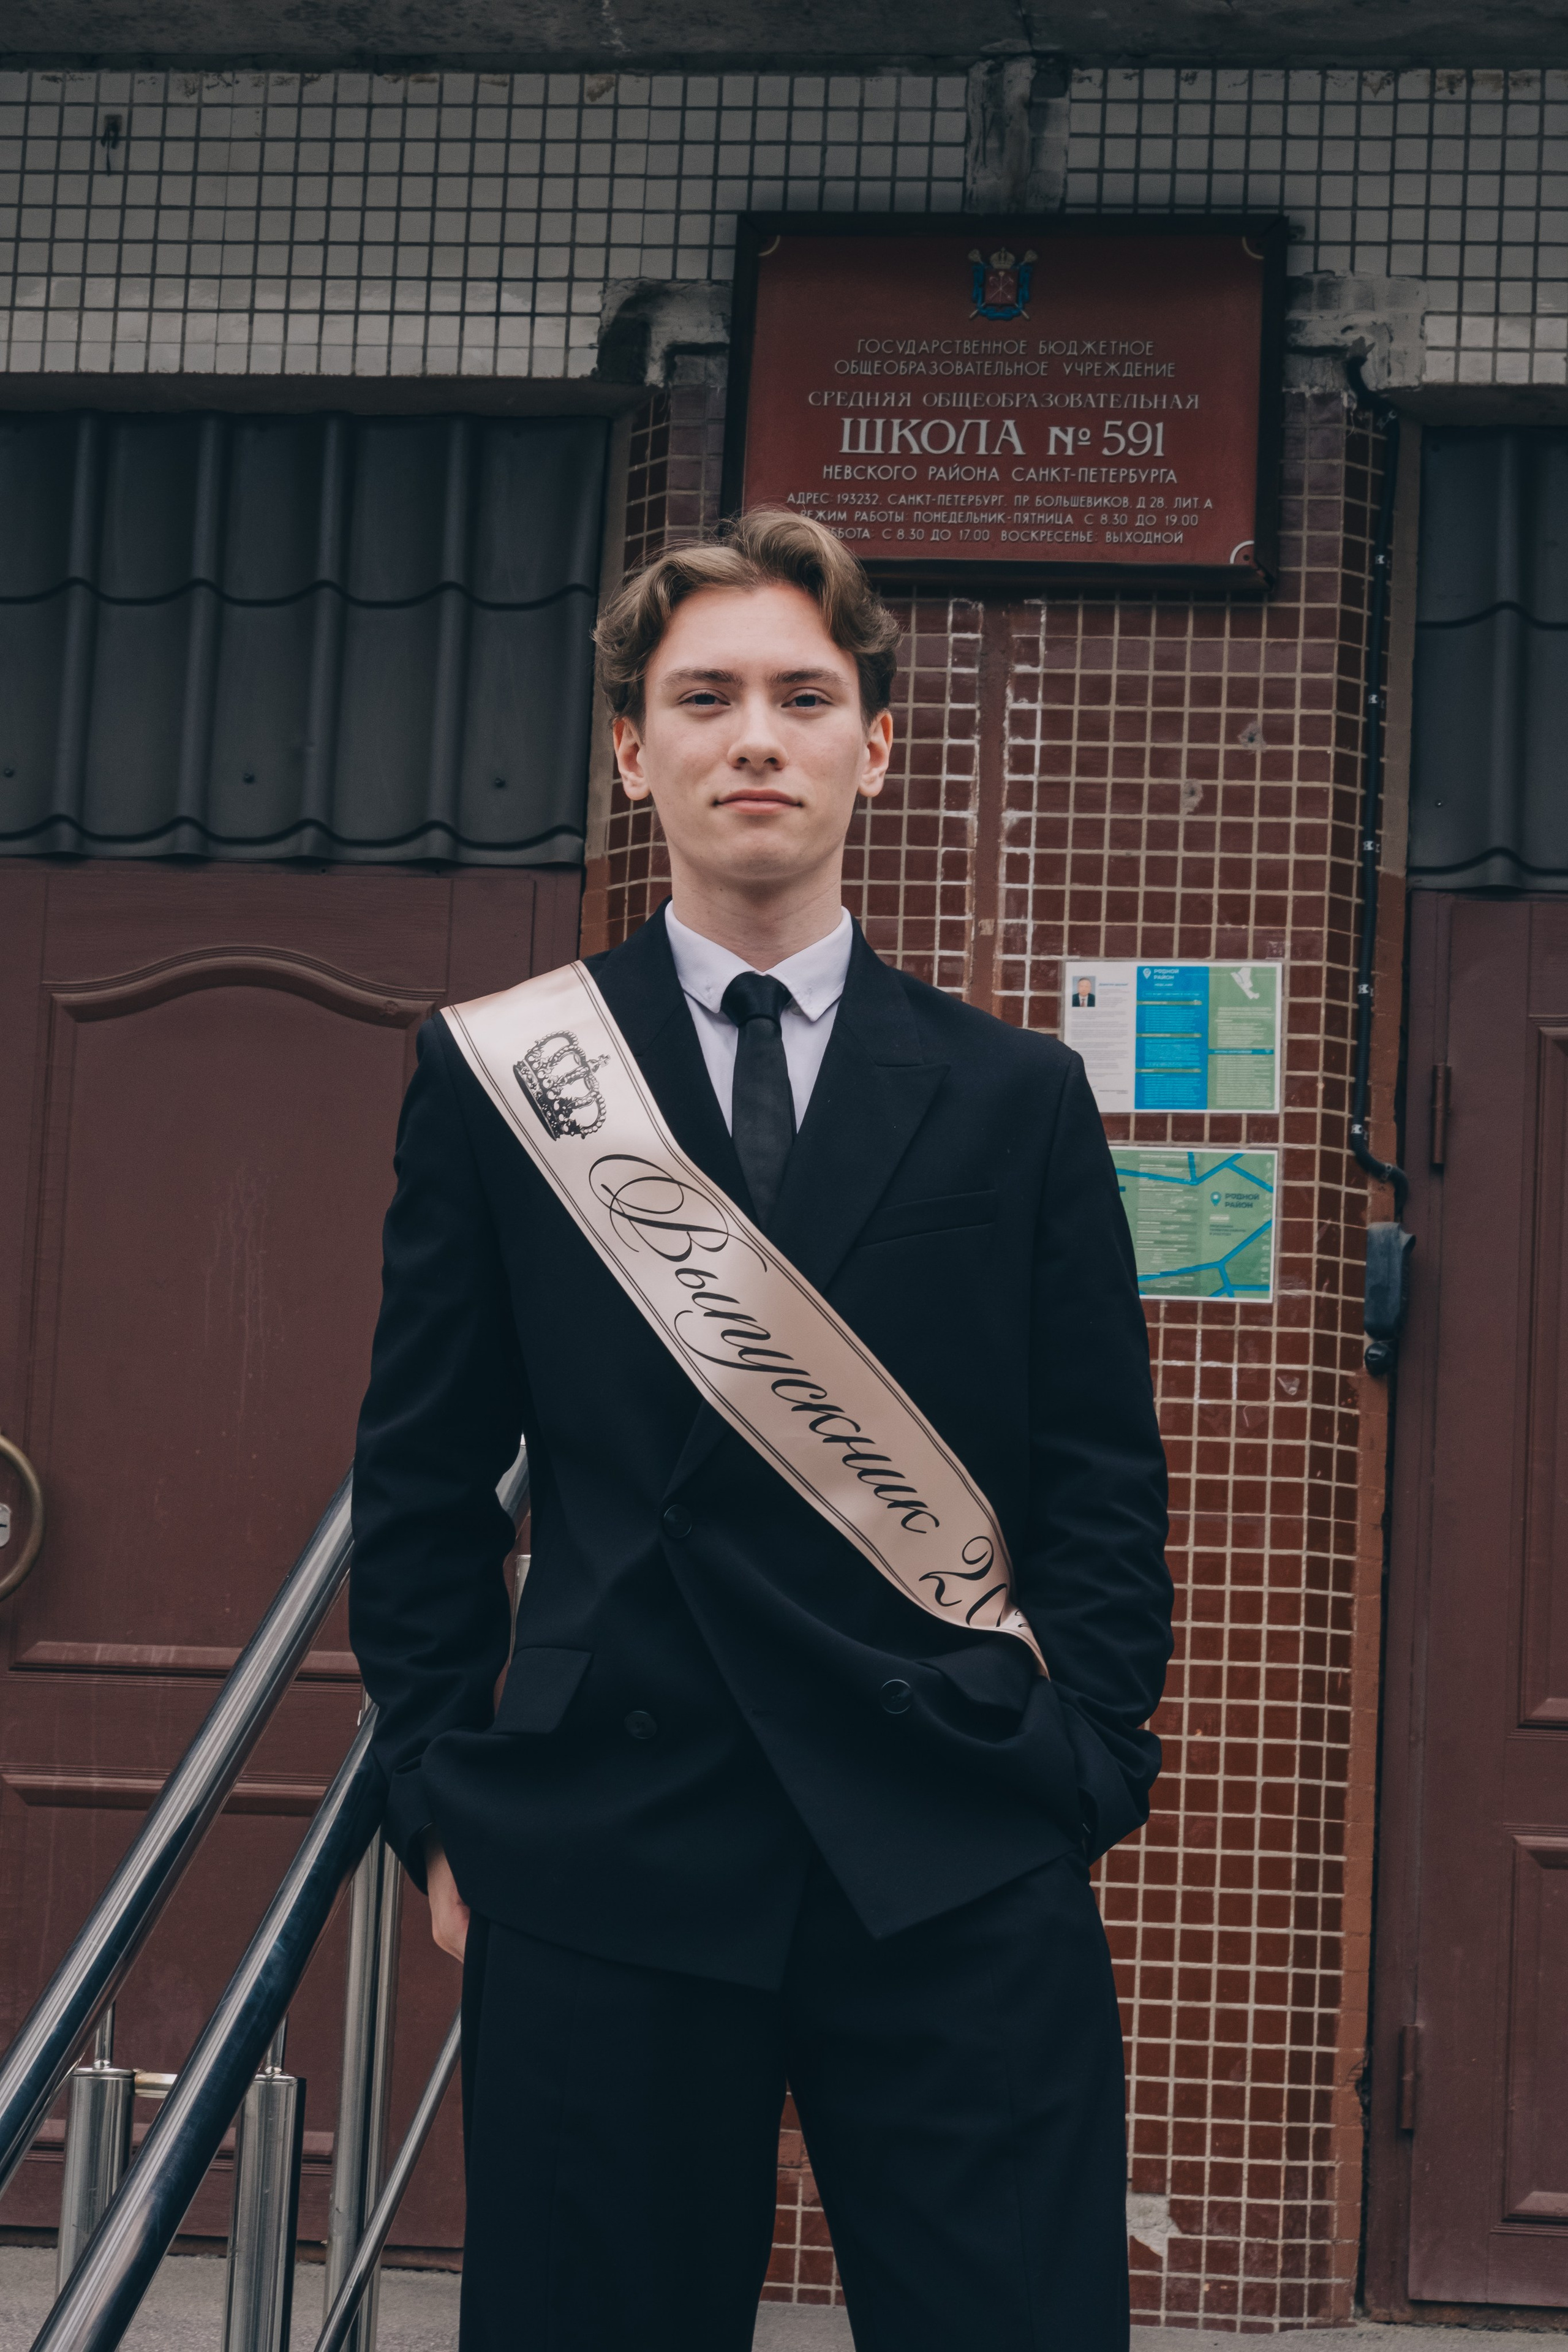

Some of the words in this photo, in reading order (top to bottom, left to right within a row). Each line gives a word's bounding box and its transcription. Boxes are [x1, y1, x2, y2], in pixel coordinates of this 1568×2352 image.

[858, 339, 1027, 355] ГОСУДАРСТВЕННОЕ
[1039, 341, 1154, 356] БЮДЖЕТНОЕ
[835, 360, 1049, 375] ОБЩЕОБРАЗОВАТЕЛЬНОЕ
[1063, 362, 1175, 377] УЧРЕЖДЕНИЕ
[809, 391, 911, 409] СРЕДНЯЯ
[922, 393, 1199, 410] ОБЩЕОБРАЗОВАТЕЛЬНАЯ
[839, 418, 1027, 455] ШКОЛА
[1046, 426, 1091, 455] №
[1101, 420, 1165, 456] 591
[823, 465, 918, 480] НЕВСКОГО
[929, 463, 1000, 481] РАЙОНА
[1011, 467, 1178, 483] САНКТ-ПЕТЕРБУРГА
[1084, 514, 1094, 524] С
[1100, 514, 1128, 525] 8.30
[1134, 514, 1157, 526] ДО
[1166, 514, 1199, 526] 19.00
[882, 529, 892, 539] С
[897, 529, 925, 540] 8.30
[930, 529, 952, 541] ДО
[960, 529, 990, 540] 17.00
[1106, 531, 1183, 543] ВЫХОДНОЙ
[589, 1153, 940, 1534] Выпускник
